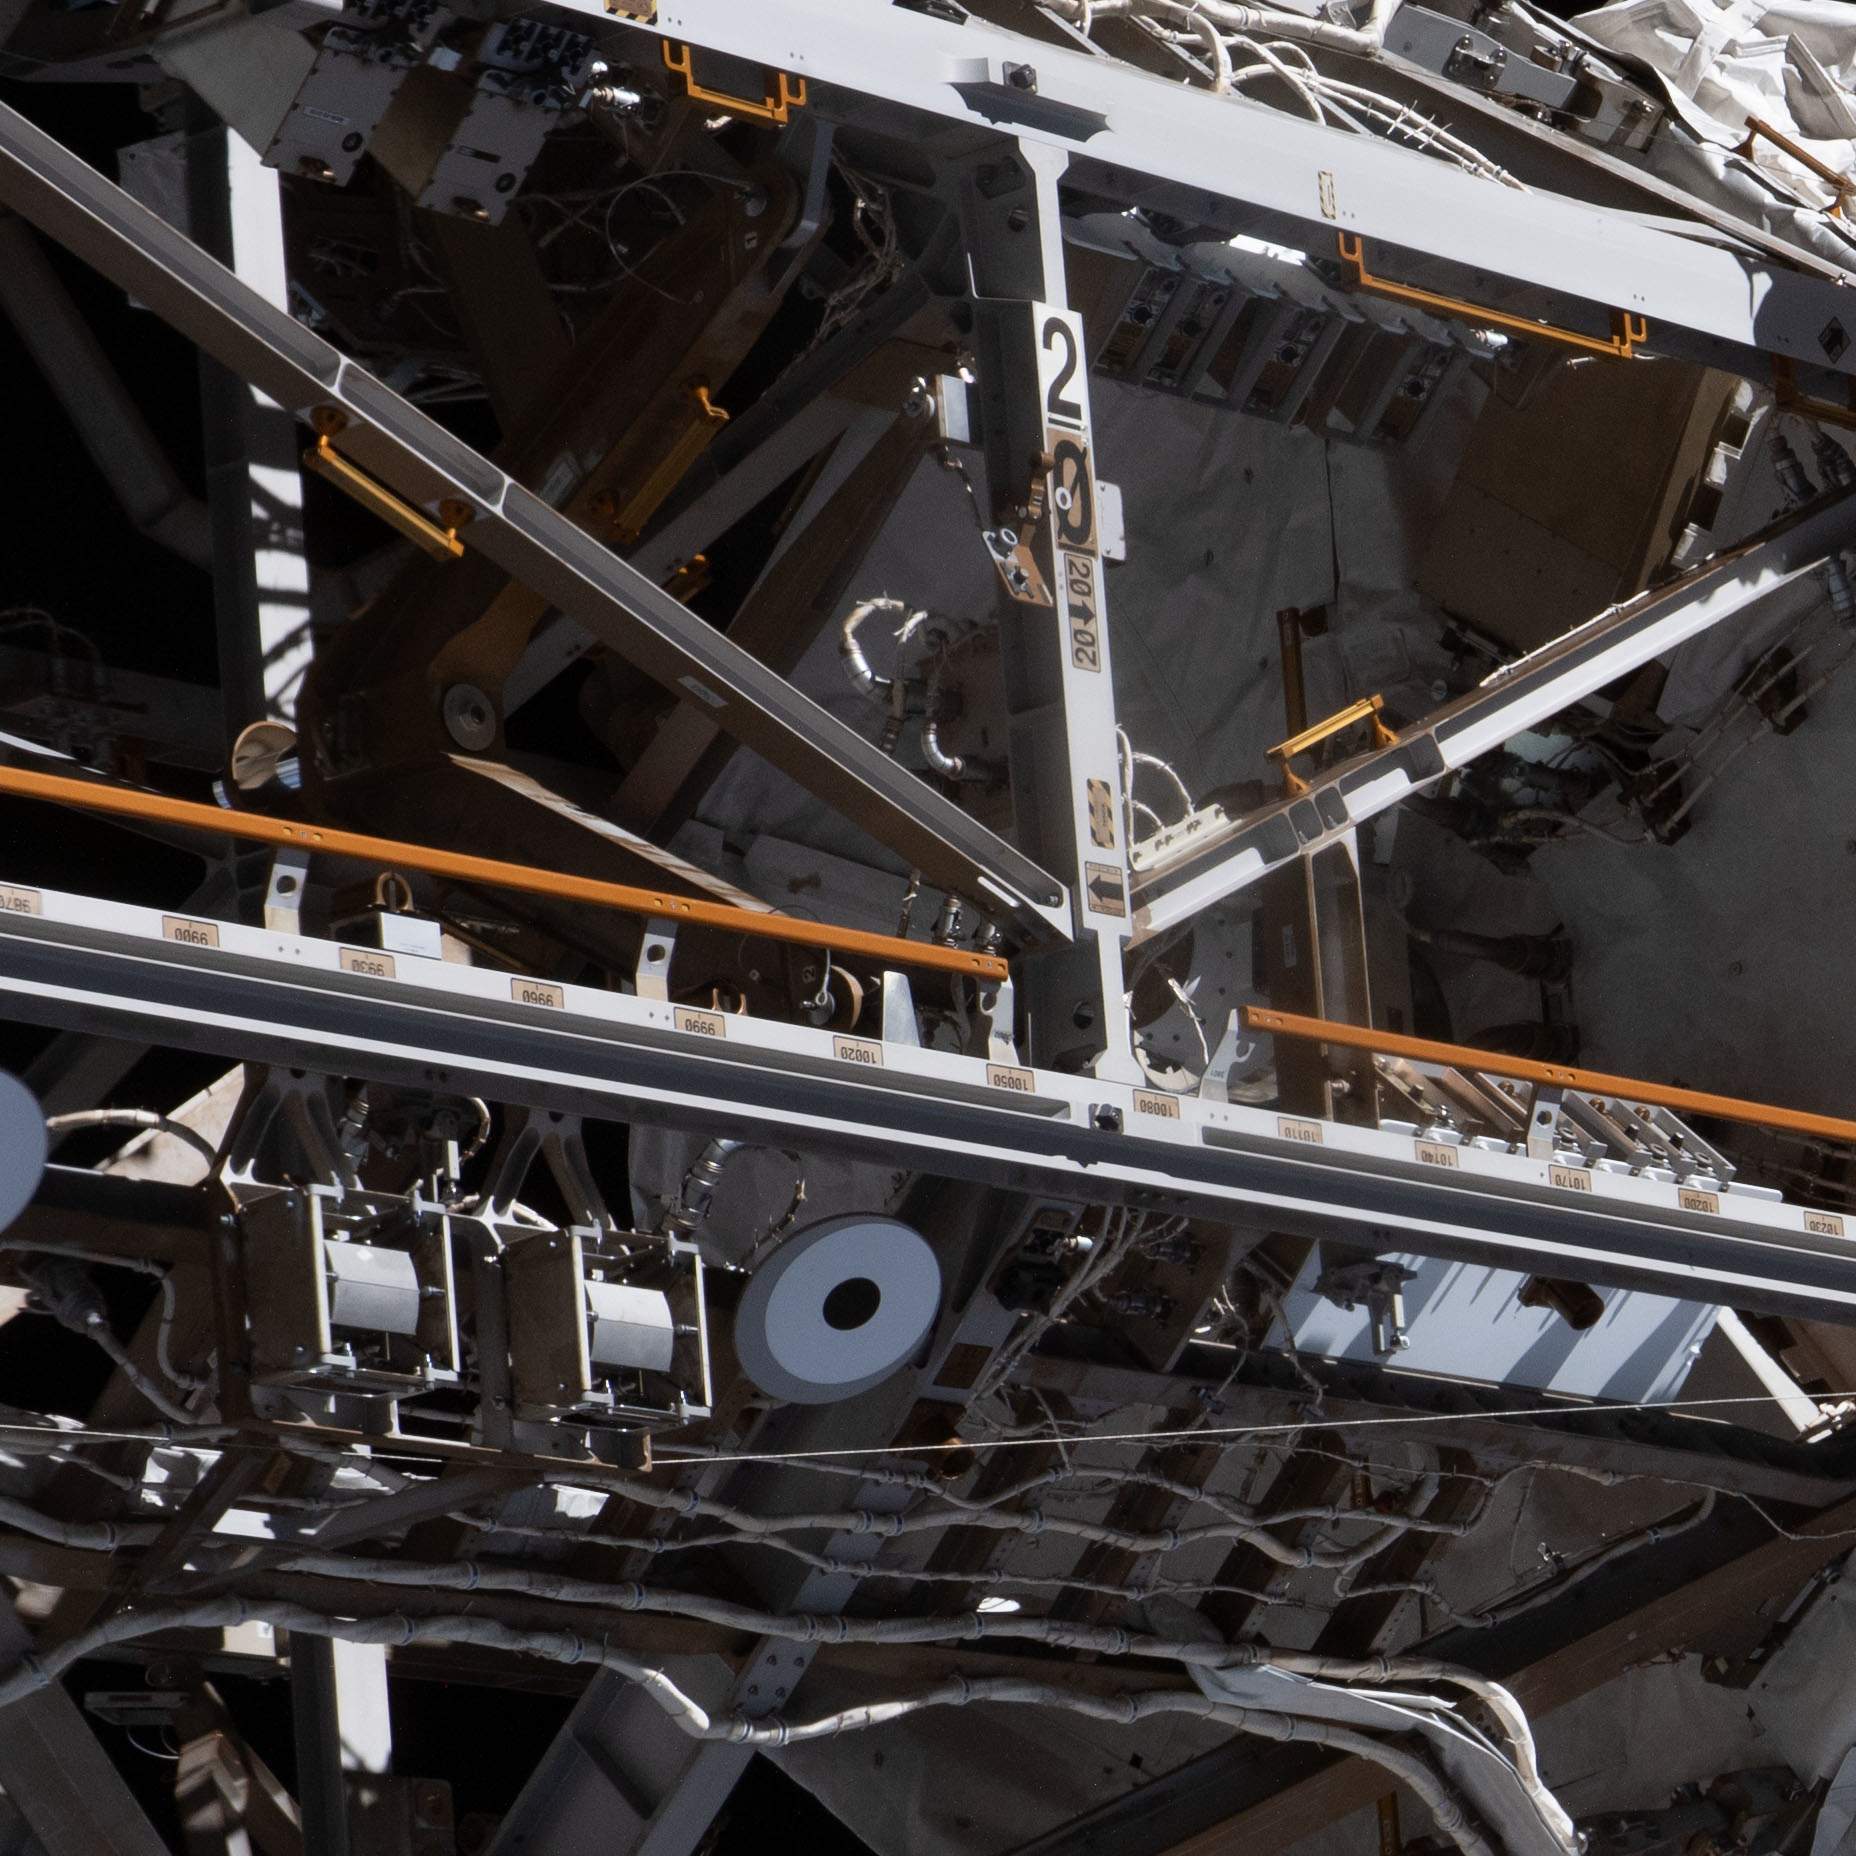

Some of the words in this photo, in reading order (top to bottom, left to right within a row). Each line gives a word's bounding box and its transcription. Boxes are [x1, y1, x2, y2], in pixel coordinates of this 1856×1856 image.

[175, 928, 208, 945] 9900
[352, 960, 384, 976] 9930
[523, 990, 553, 1007] 9960
[686, 1019, 715, 1035] 9990
[841, 1047, 877, 1064] 10020
[994, 1074, 1028, 1091] 10050
[1140, 1100, 1173, 1117] 10080
[1422, 1151, 1452, 1165] 10140
[1556, 1175, 1585, 1189] 10170
[1684, 1198, 1714, 1212] 10200
[1810, 1221, 1838, 1235] 10230
